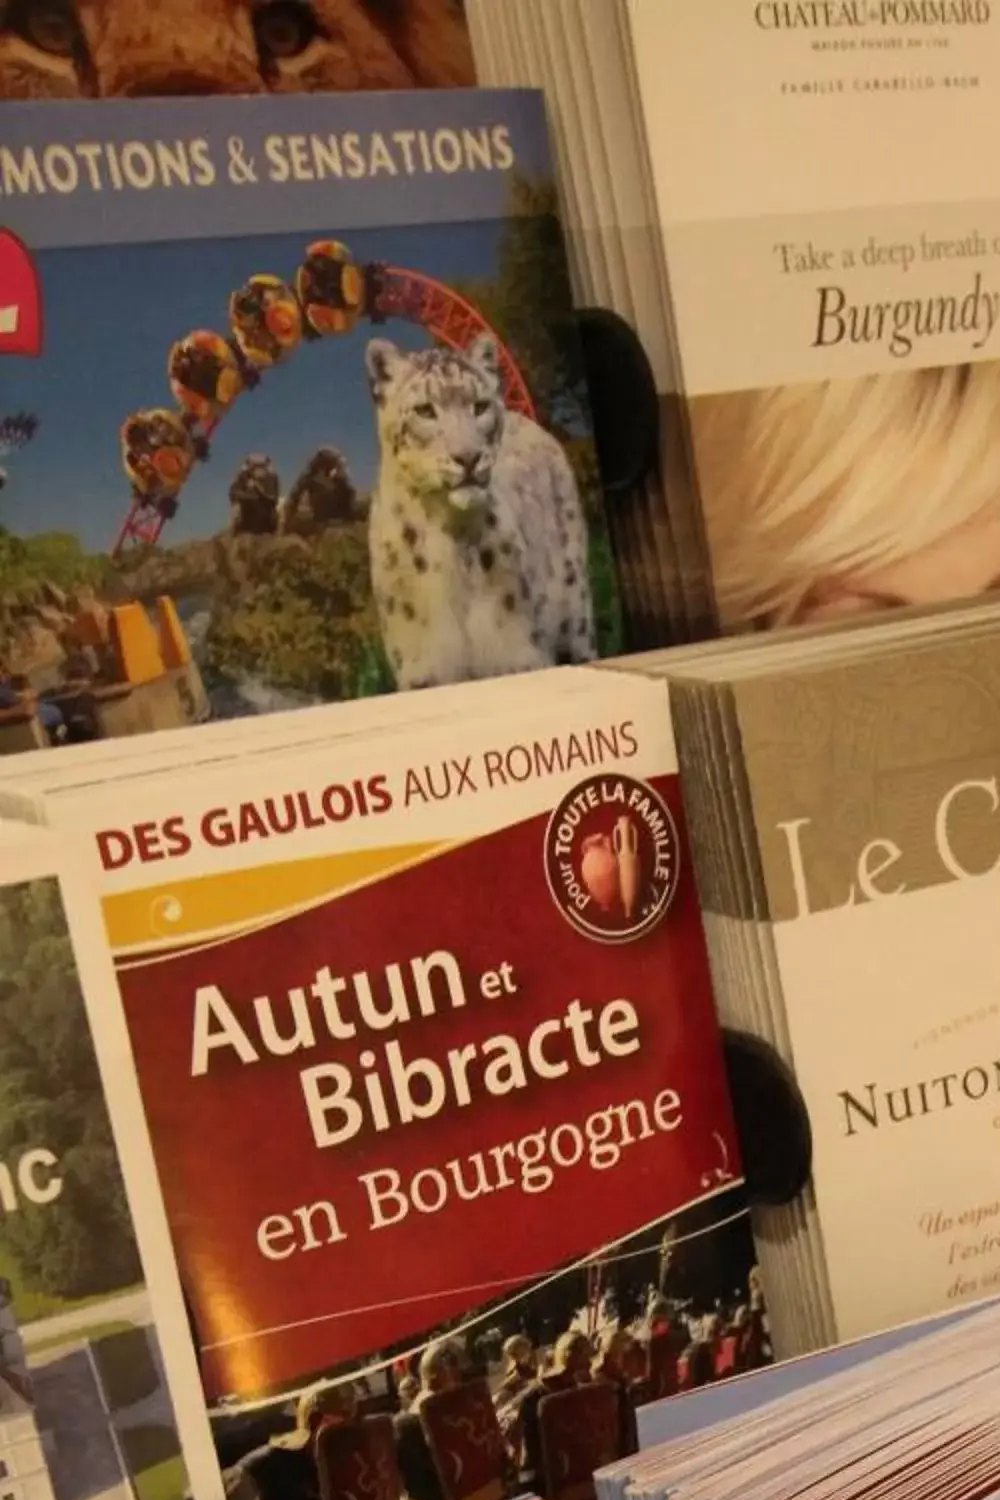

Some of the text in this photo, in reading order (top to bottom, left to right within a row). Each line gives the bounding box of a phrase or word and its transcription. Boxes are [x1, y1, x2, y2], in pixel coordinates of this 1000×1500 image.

[0, 125, 516, 196] MOTIONS & SENSATIONS
[773, 241, 836, 274] Take
[841, 249, 856, 270] a
[861, 235, 916, 273] deep
[919, 228, 988, 263] breath
[810, 271, 1000, 359] Burgundy
[95, 720, 640, 872] DES GAULOIS AUX ROMAINS
[554, 781, 672, 912] pour TOUTE LA FAMILLE
[775, 815, 907, 922] Le
[188, 947, 518, 1079] Autun et
[299, 996, 642, 1151] Bibracte
[255, 1086, 685, 1262] en Bourgogne
